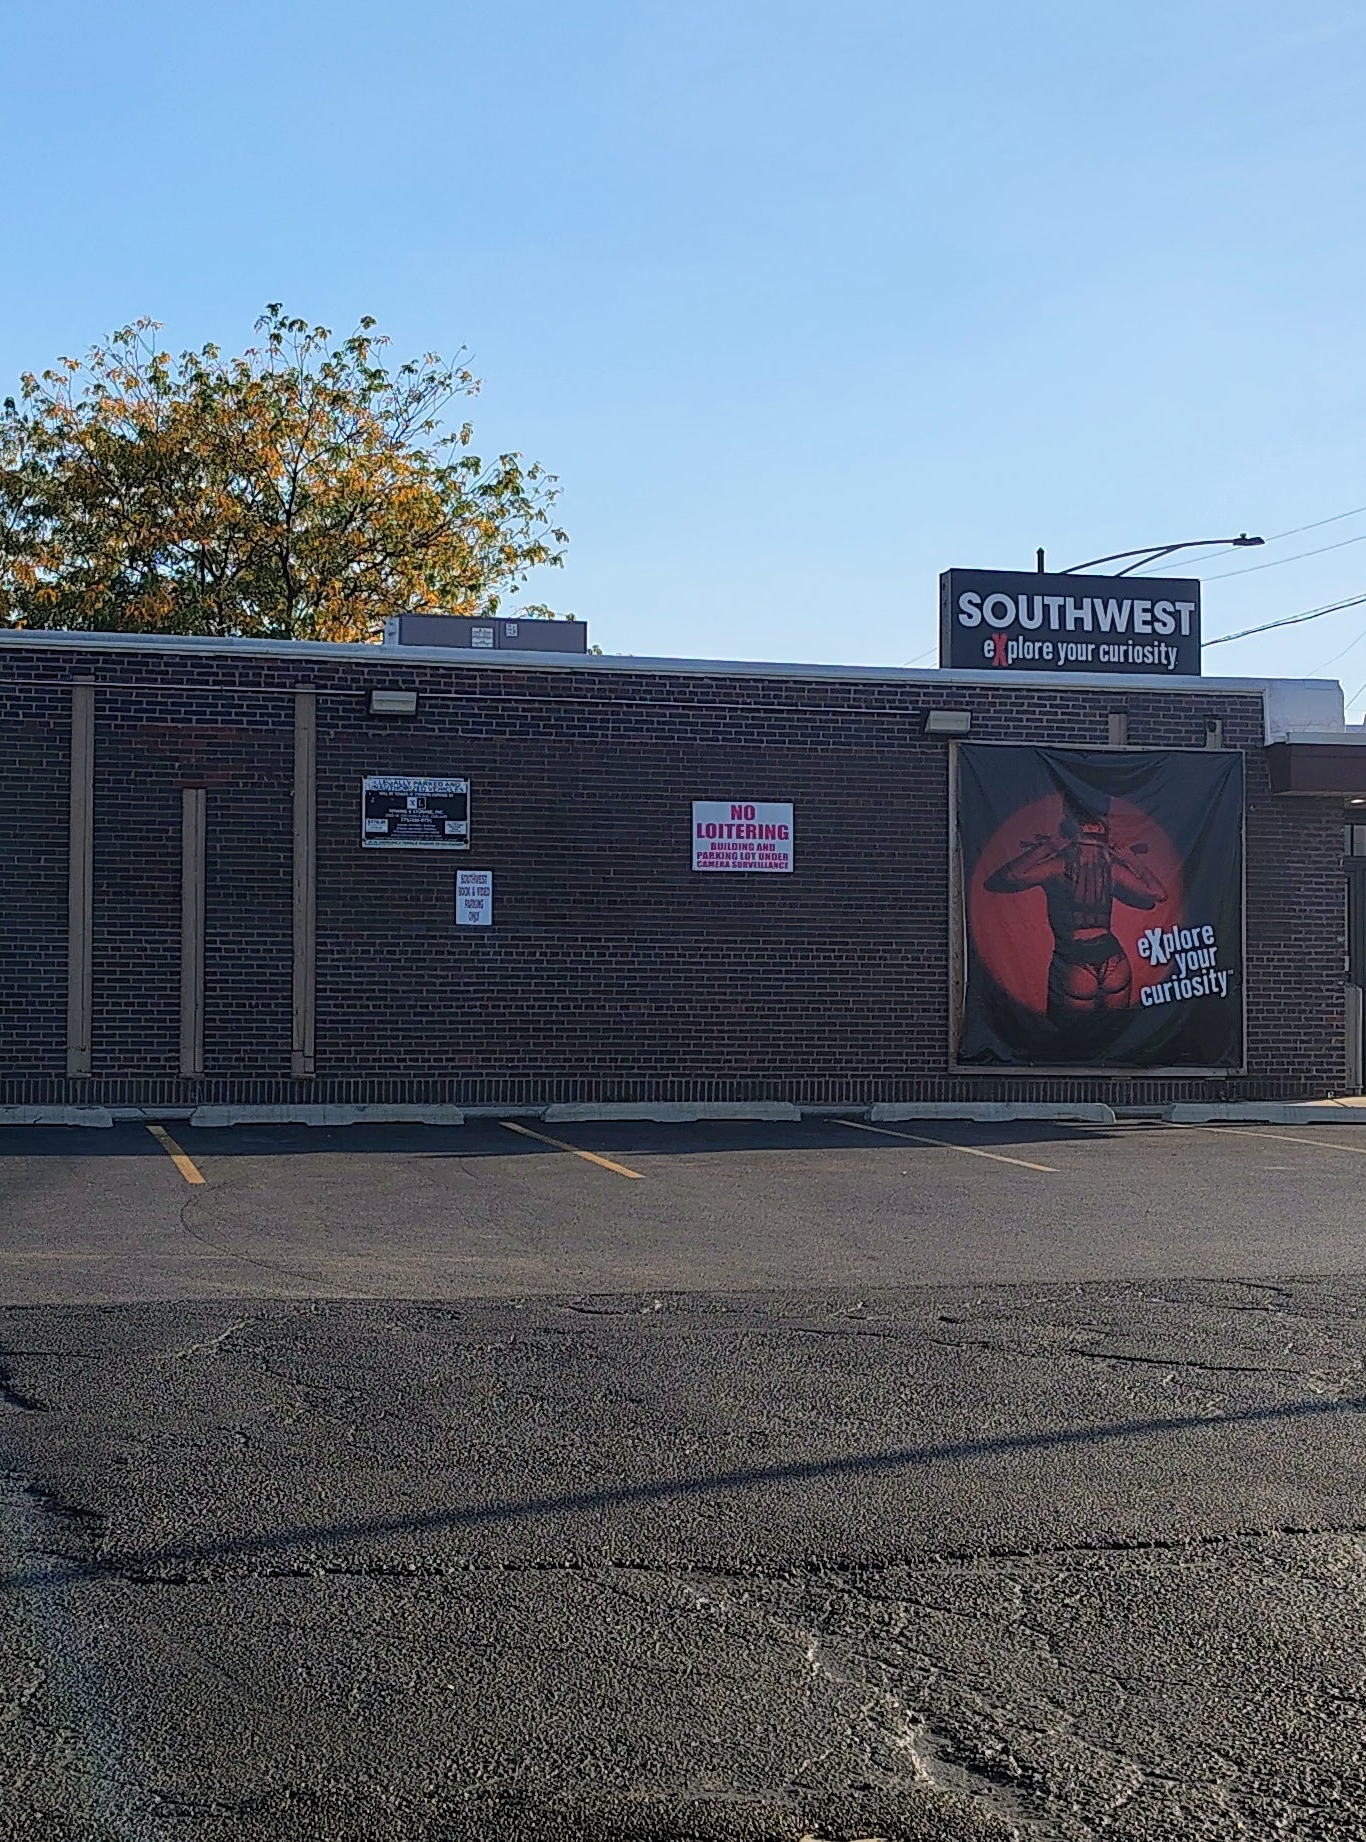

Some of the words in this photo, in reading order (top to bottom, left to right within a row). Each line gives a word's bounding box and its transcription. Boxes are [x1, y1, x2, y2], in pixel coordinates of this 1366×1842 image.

[958, 591, 1195, 636] SOUTHWEST
[983, 633, 1053, 668] eXplore
[1057, 642, 1095, 667] your
[730, 804, 756, 821] NO
[696, 822, 790, 840] LOITERING
[696, 851, 738, 861] PARKING
[739, 852, 757, 861] LOT
[758, 852, 789, 861] UNDER
[710, 842, 755, 852] BUILDING
[756, 843, 776, 852] AND
[696, 860, 731, 868] CAMERA
[731, 861, 789, 870] SURVEILLANCE
[1137, 925, 1215, 966] eXplore
[1175, 946, 1218, 979] your
